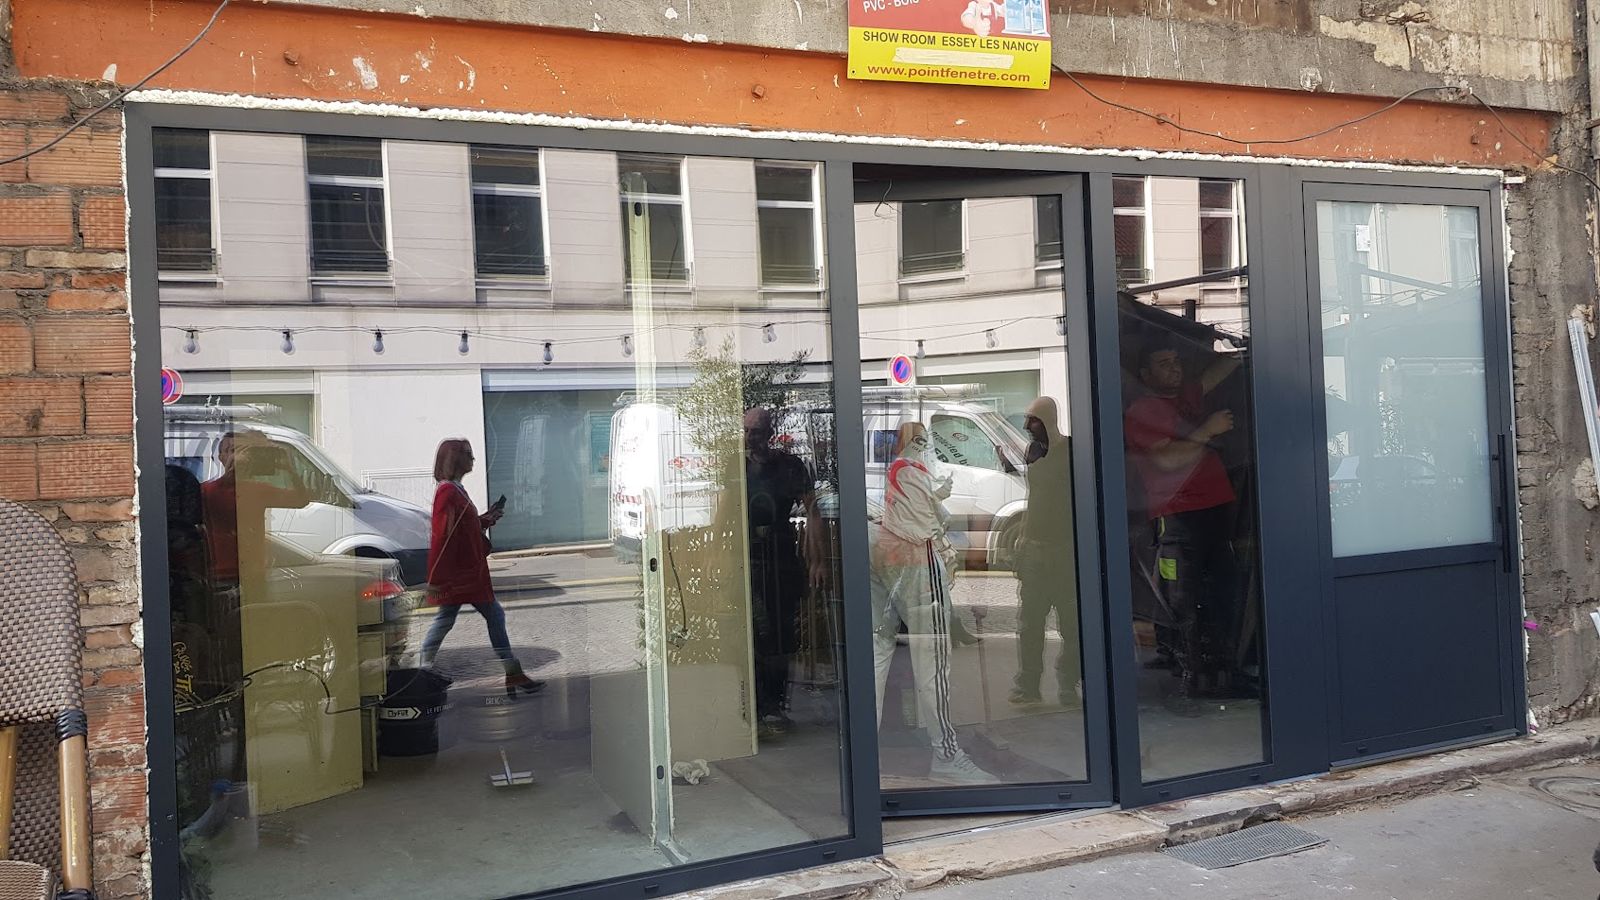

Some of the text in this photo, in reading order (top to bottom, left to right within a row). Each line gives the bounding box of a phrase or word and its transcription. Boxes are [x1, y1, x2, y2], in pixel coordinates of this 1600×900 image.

[863, 0, 886, 13] PVC
[863, 31, 1039, 52] SHOW ROOM ESSEY LES NANCY
[867, 65, 1031, 82] www.pointfenetre.com
